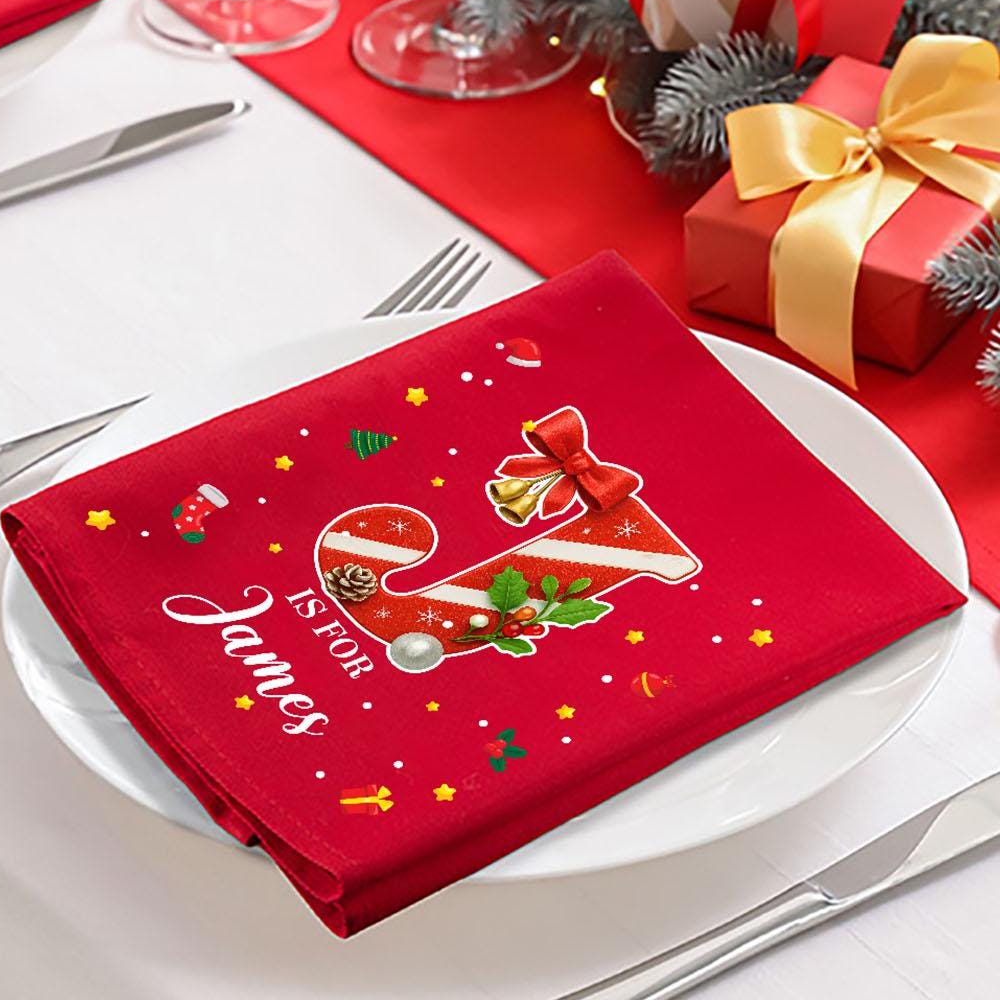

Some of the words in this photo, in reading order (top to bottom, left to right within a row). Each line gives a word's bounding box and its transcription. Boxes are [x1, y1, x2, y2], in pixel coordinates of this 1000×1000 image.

[314, 406, 703, 673] J
[162, 585, 330, 736] James
[285, 587, 329, 619] IS
[312, 619, 374, 680] FOR
